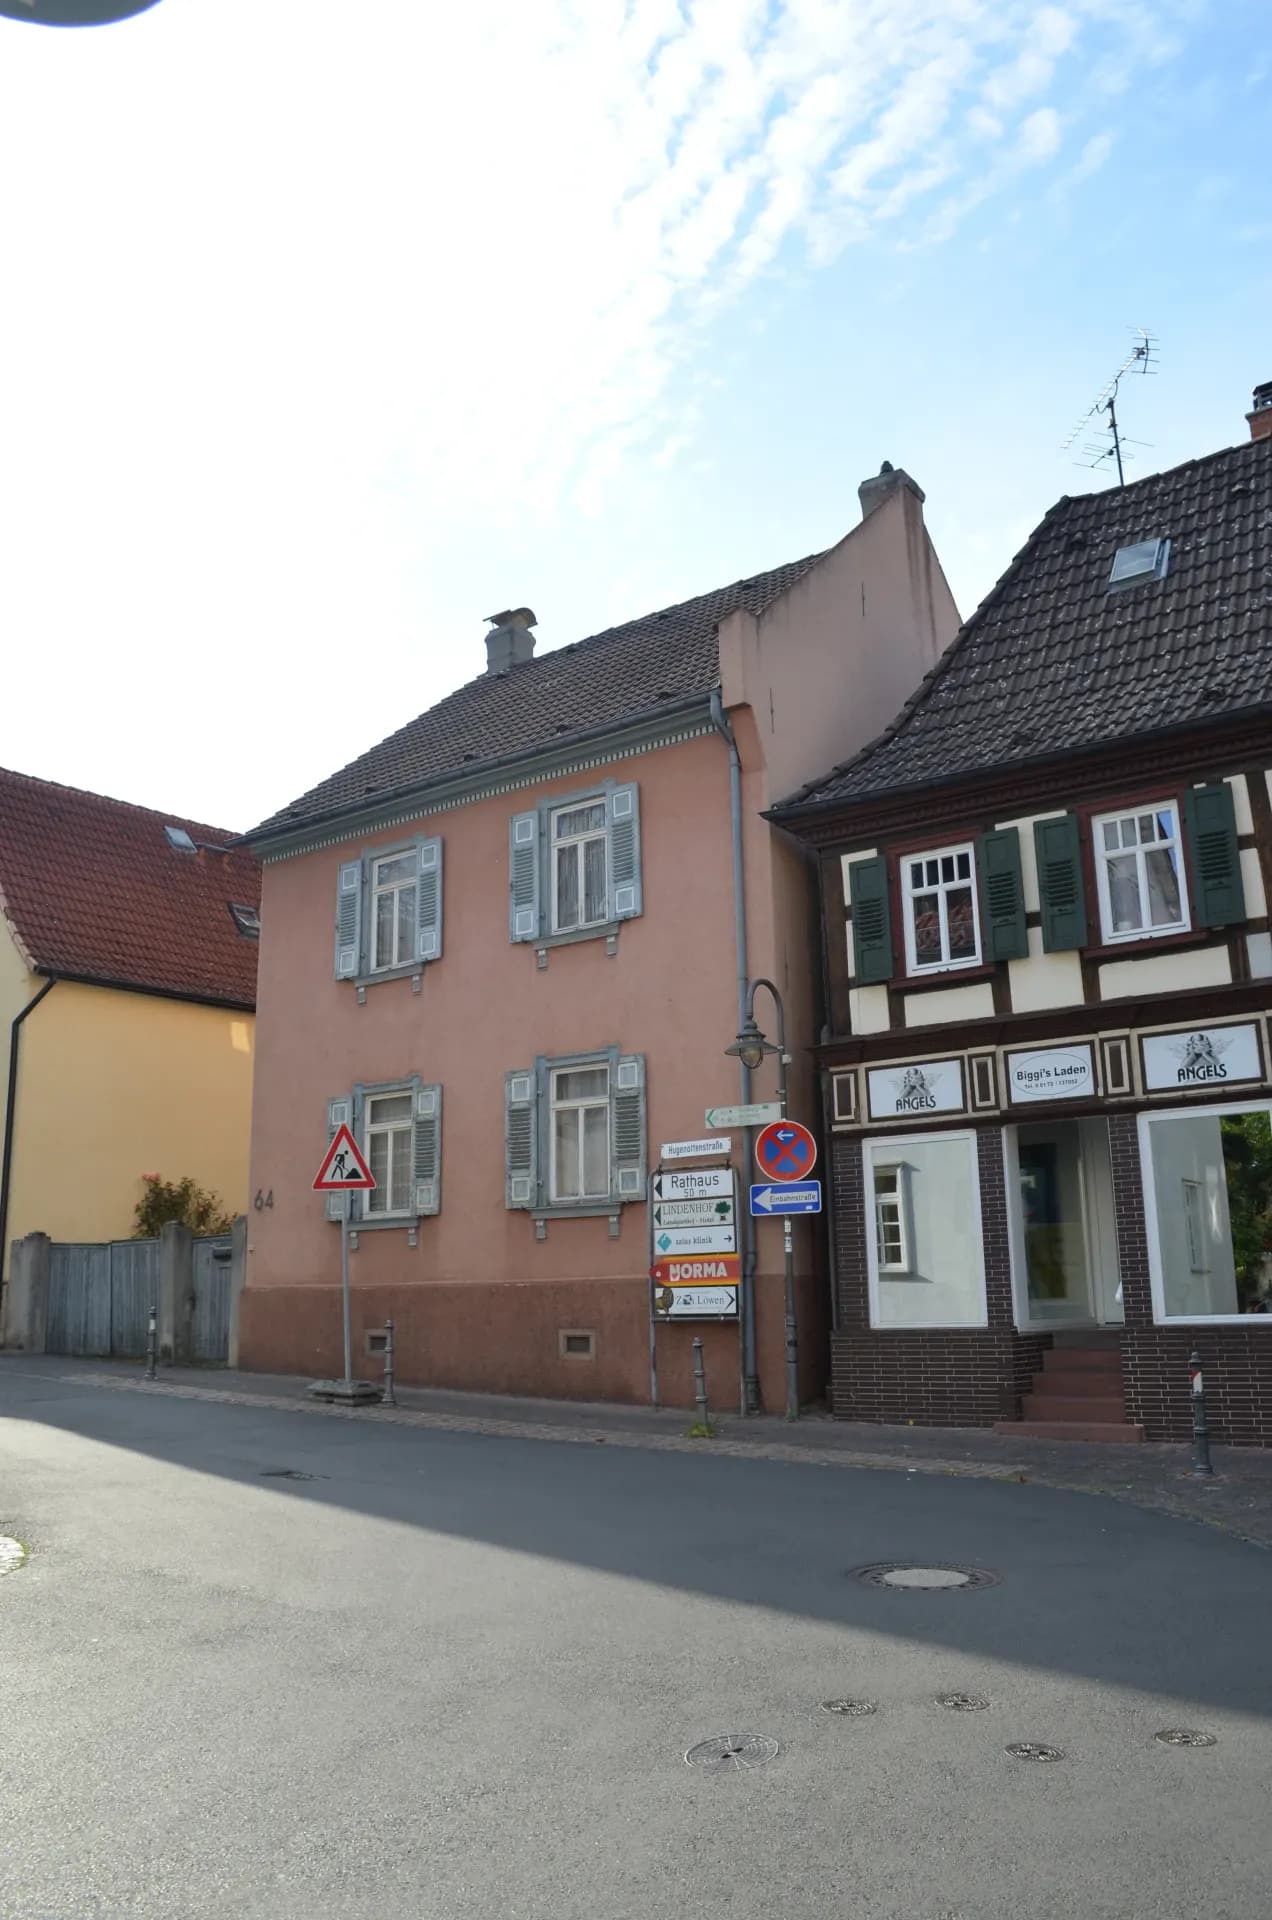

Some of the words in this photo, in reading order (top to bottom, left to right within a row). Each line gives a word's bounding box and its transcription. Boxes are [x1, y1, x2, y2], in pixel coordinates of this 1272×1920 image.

[1017, 1068, 1051, 1081] Biggi's
[1054, 1065, 1086, 1076] Laden
[1177, 1064, 1227, 1082] ANGELS
[896, 1095, 936, 1112] ANGELS
[668, 1140, 723, 1155] Hugenottenstraße
[671, 1174, 719, 1188] Rathaus
[254, 1189, 274, 1211] 64
[684, 1188, 694, 1197] 50
[663, 1202, 714, 1216] LINDENHOF
[669, 1262, 728, 1282] NORMA
